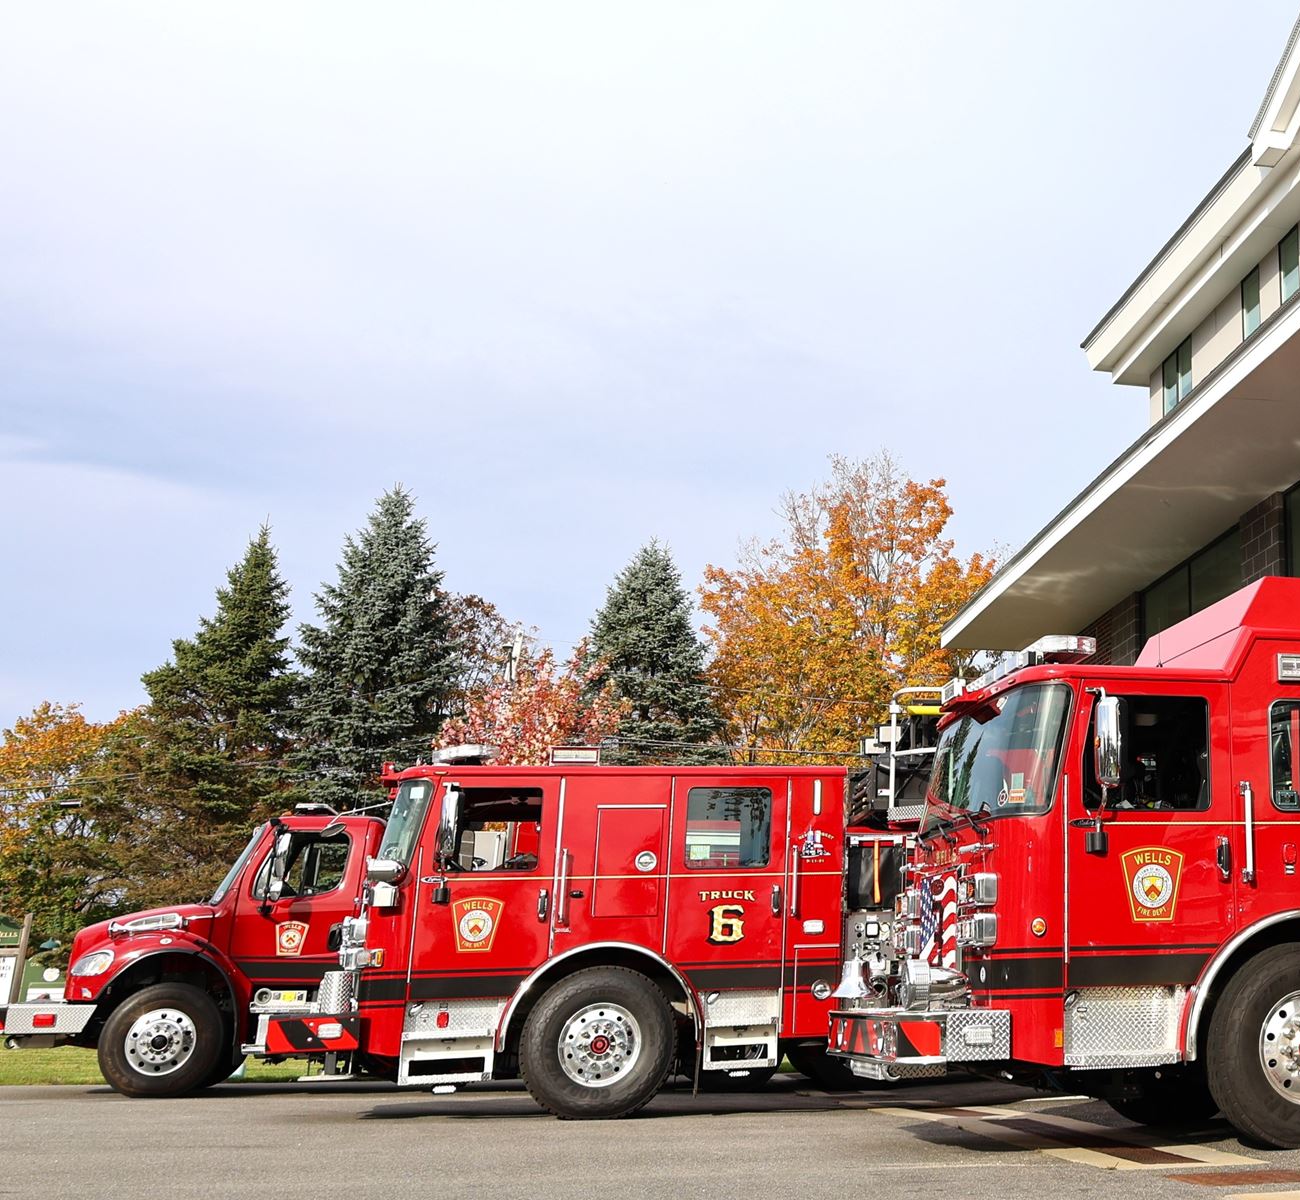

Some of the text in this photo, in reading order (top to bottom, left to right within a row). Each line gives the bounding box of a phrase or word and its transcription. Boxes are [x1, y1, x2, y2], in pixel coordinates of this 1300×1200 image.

[1133, 852, 1172, 866] WELLS
[698, 890, 757, 902] TRUCK
[462, 900, 494, 911] WELLS
[1136, 906, 1150, 917] FIRE
[708, 904, 745, 945] 6
